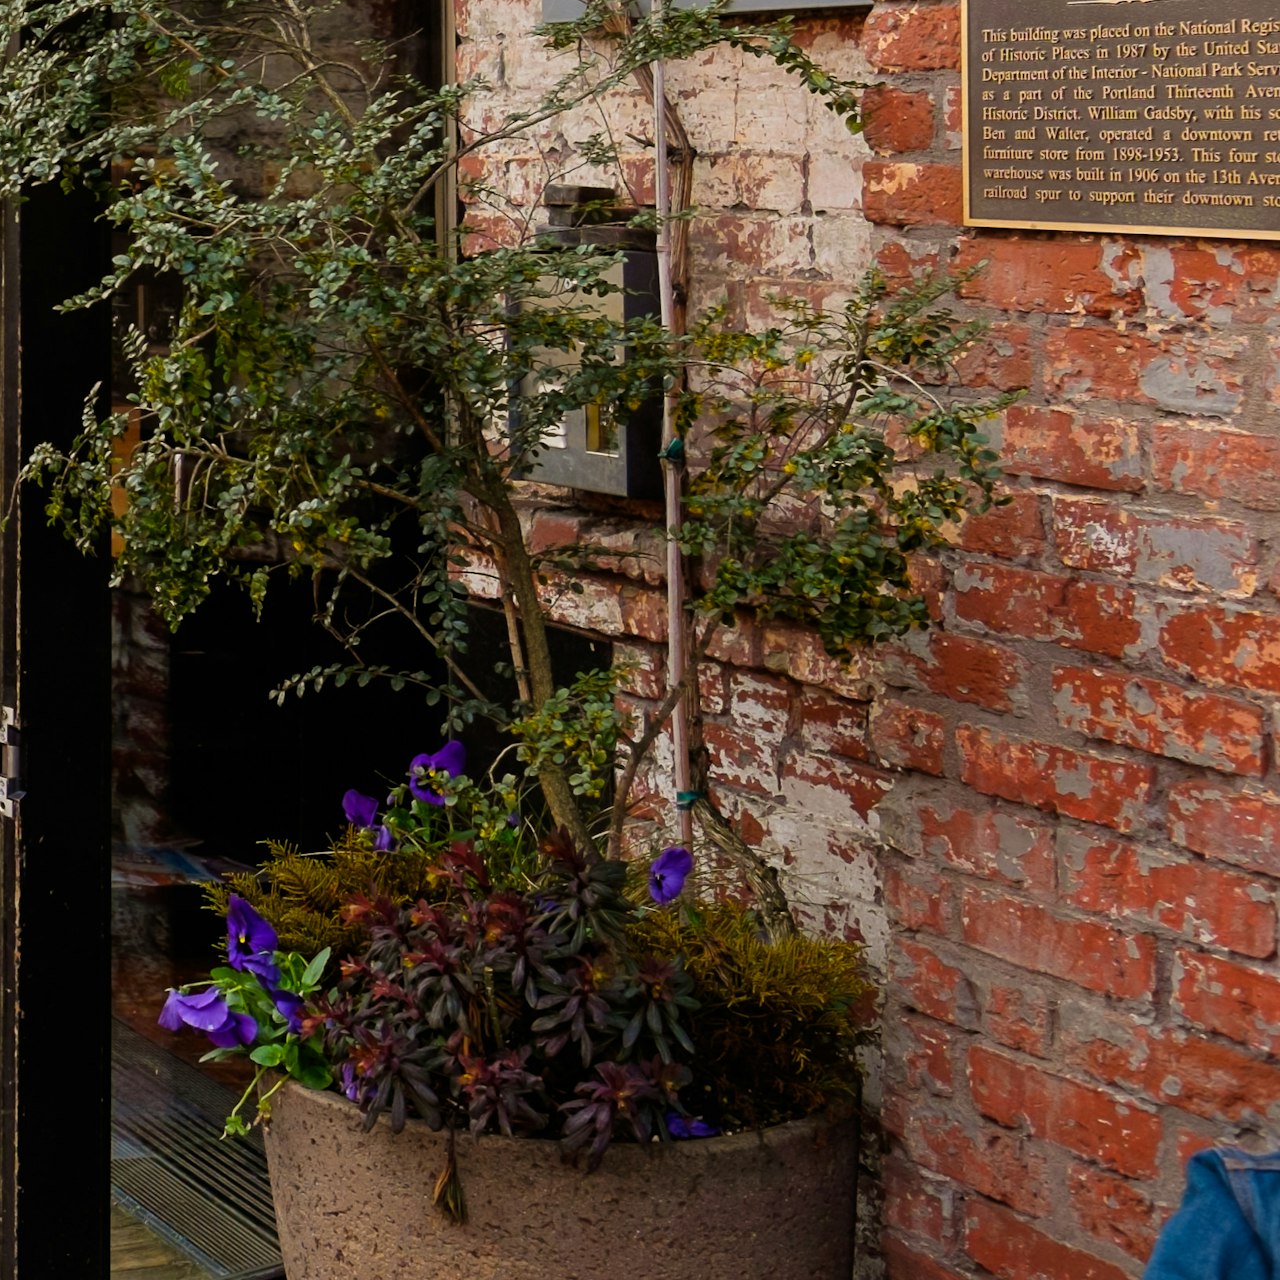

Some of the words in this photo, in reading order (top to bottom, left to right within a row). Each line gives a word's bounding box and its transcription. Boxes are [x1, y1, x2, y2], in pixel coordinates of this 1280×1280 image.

[982, 27, 1007, 42] This
[1010, 26, 1059, 43] building
[1063, 29, 1086, 40] was
[1090, 23, 1130, 42] placed
[1134, 26, 1150, 37] on
[1155, 21, 1175, 36] the
[1180, 19, 1236, 36] National
[982, 48, 996, 62] of
[1000, 46, 1046, 62] Historic
[1052, 45, 1090, 60] Places
[1096, 45, 1108, 59] in
[1117, 44, 1146, 58] 1987
[1153, 42, 1170, 60] by
[1176, 42, 1198, 56] the
[1204, 40, 1249, 55] United
[1257, 39, 1280, 55] Sta
[982, 67, 1049, 84] Department
[1052, 66, 1067, 80] of
[1069, 66, 1088, 80] the
[1091, 64, 1137, 80] Interior
[1151, 62, 1207, 78] National
[1212, 62, 1243, 77] Park
[982, 90, 995, 101] as
[1003, 90, 1010, 100] a
[1019, 87, 1042, 103] part
[1051, 86, 1066, 100] of
[1074, 86, 1093, 100] the
[1103, 84, 1156, 100] Portland
[1165, 83, 1234, 99] Thirteenth
[983, 106, 1028, 120] Historic
[1034, 106, 1081, 120] District.
[1088, 105, 1137, 120] William
[1144, 105, 1198, 123] Gadsby,
[1204, 105, 1234, 120] with
[1240, 104, 1261, 120] his
[983, 126, 1005, 140] Ben
[1014, 126, 1036, 140] and
[1045, 126, 1090, 142] Walter,
[1099, 127, 1153, 144] operated
[1163, 130, 1171, 141] a
[1181, 126, 1252, 141] downtown
[983, 145, 1033, 160] furniture
[1040, 148, 1069, 160] store
[1076, 146, 1105, 161] from
[1113, 147, 1184, 162] 1898-1953.
[1191, 147, 1221, 162] This
[1229, 148, 1258, 163] four
[983, 166, 1044, 180] warehouse
[1048, 169, 1072, 181] was
[1076, 167, 1104, 181] built
[1110, 167, 1122, 182] in
[1129, 167, 1159, 182] 1906
[1163, 171, 1180, 183] on
[1185, 169, 1207, 184] the
[1213, 169, 1241, 184] 13th
[983, 186, 1028, 199] railroad
[1035, 189, 1062, 203] spur
[1069, 190, 1081, 201] to
[1089, 191, 1135, 206] support
[1144, 189, 1175, 204] their
[1182, 190, 1253, 206] downtown
